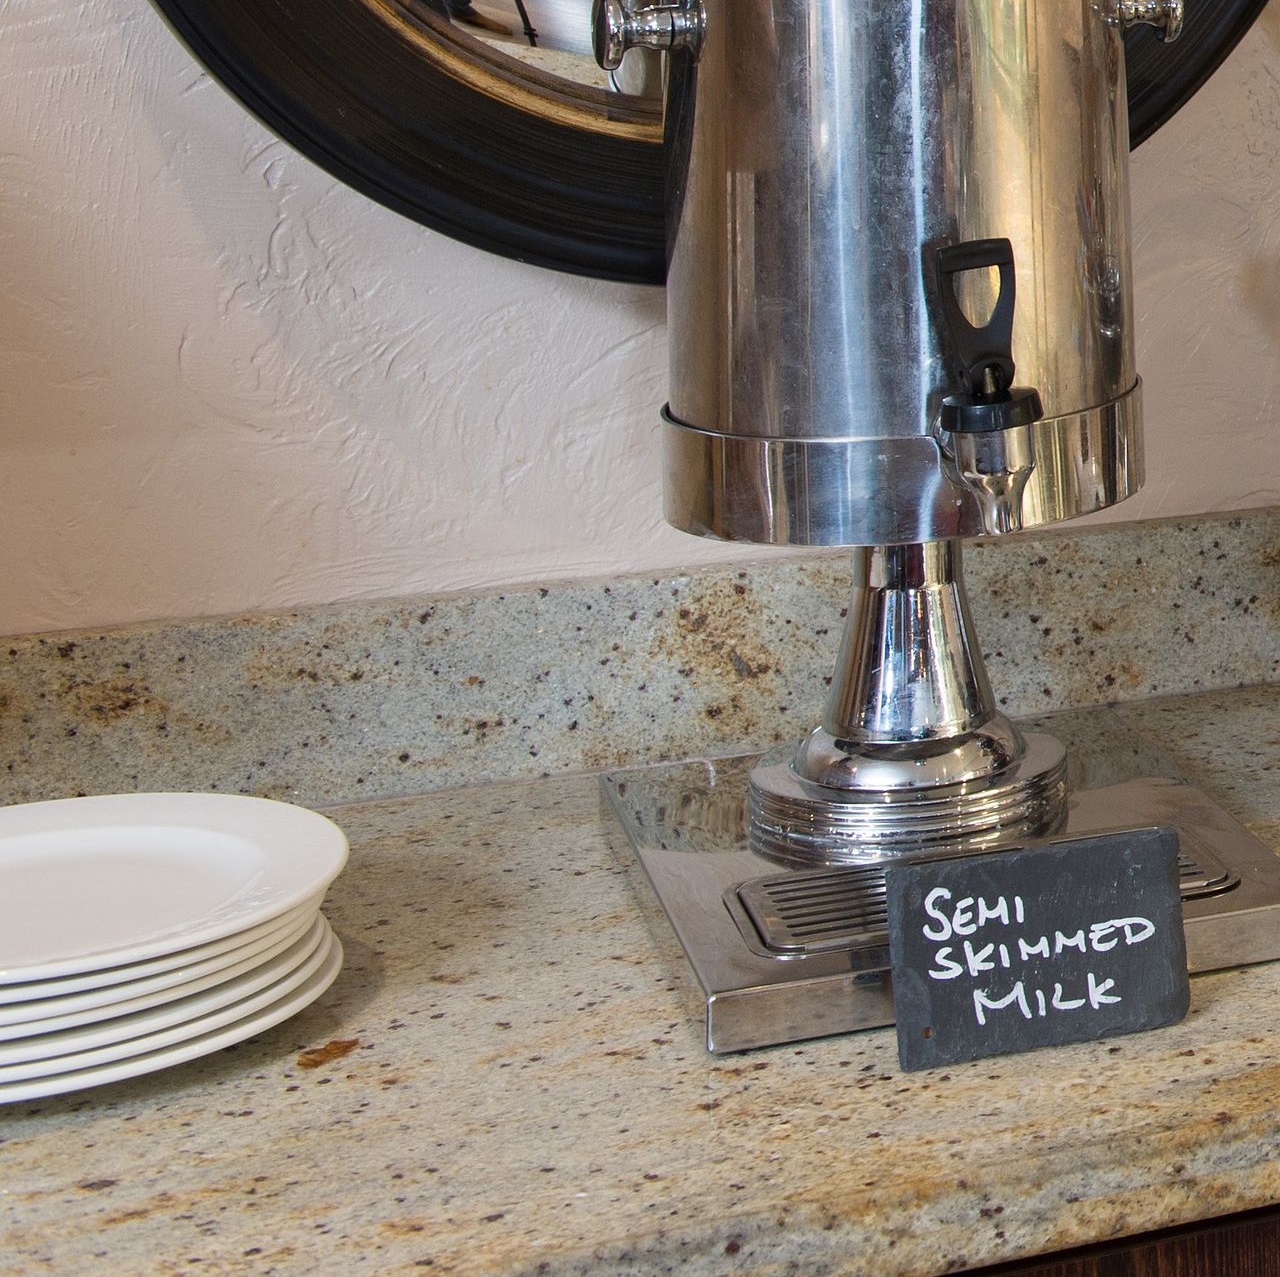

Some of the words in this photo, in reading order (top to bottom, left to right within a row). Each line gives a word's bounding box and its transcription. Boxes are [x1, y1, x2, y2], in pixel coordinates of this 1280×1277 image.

[923, 887, 1025, 941] SEMI
[928, 916, 1156, 980] SKIMMED
[973, 972, 1122, 1025] MILK
